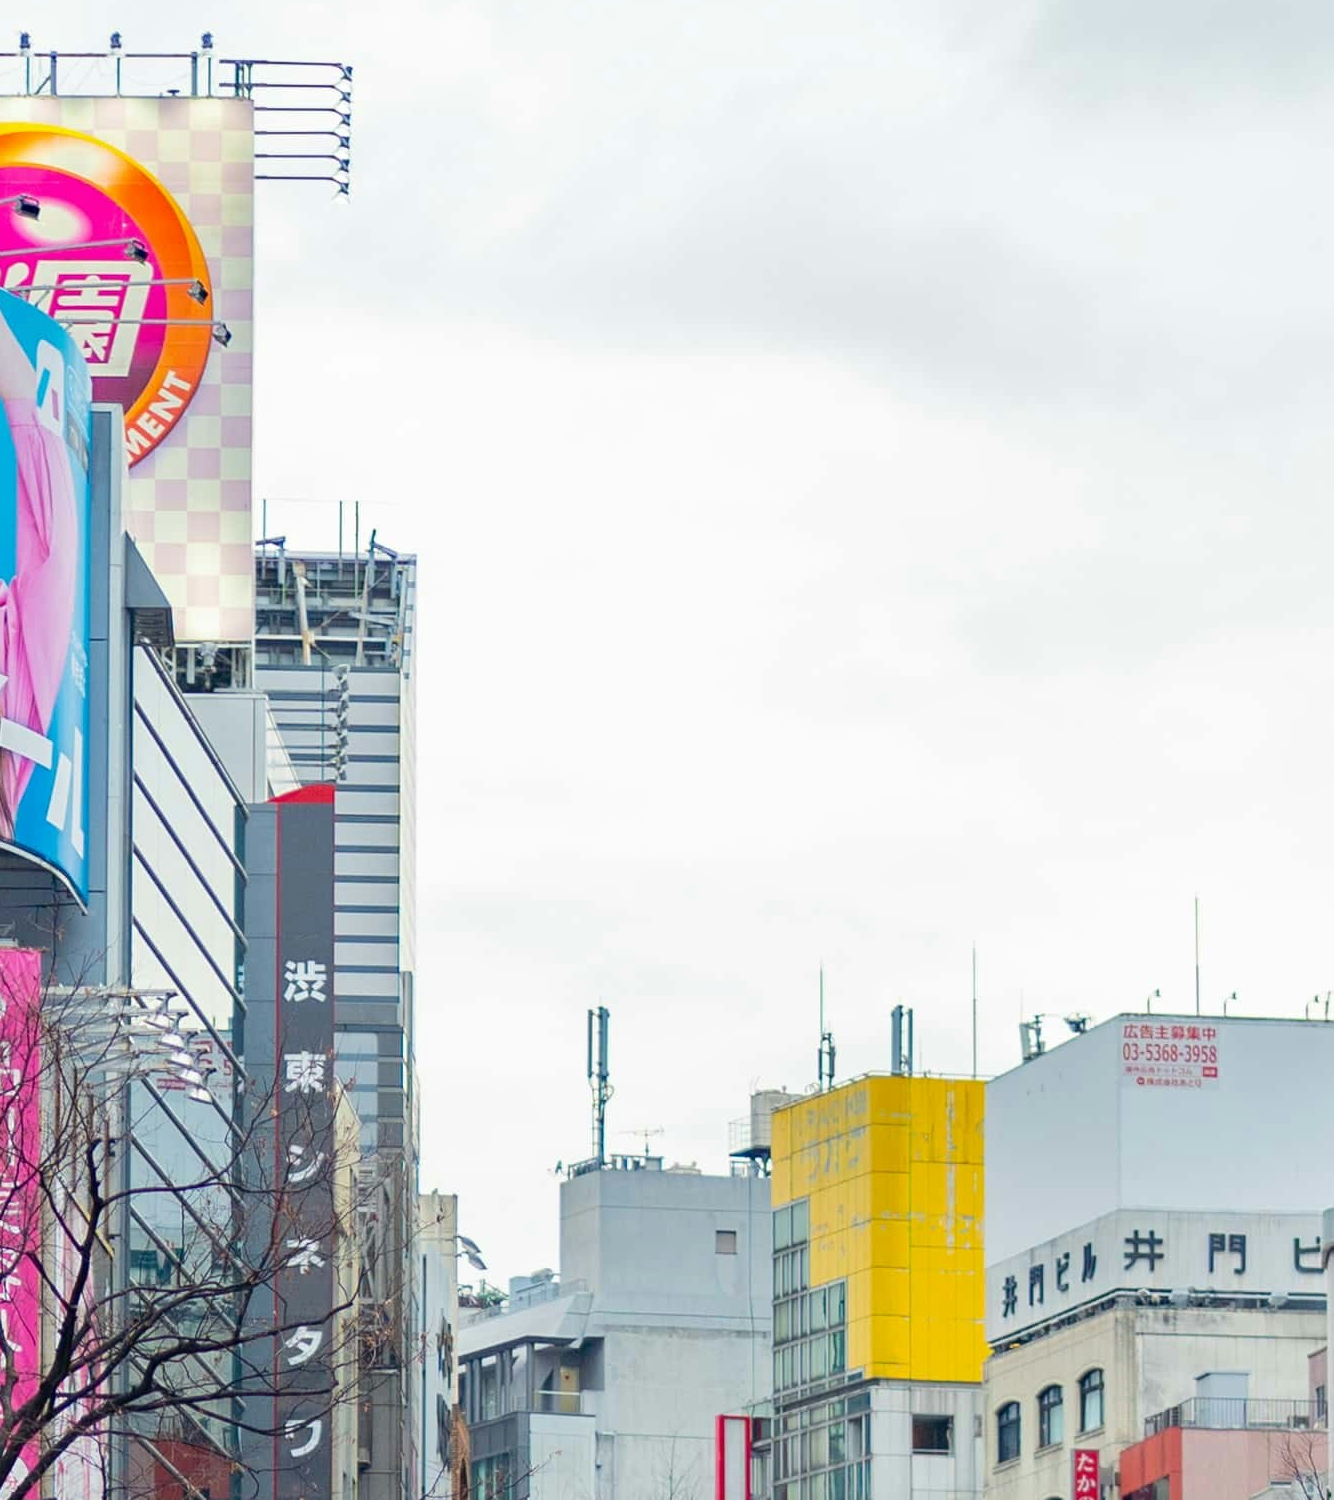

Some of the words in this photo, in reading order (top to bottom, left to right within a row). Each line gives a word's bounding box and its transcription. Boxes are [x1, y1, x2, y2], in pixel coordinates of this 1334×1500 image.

[1123, 1043, 1218, 1064] 03-5368-3958
[1002, 1240, 1098, 1320] 井門ビル
